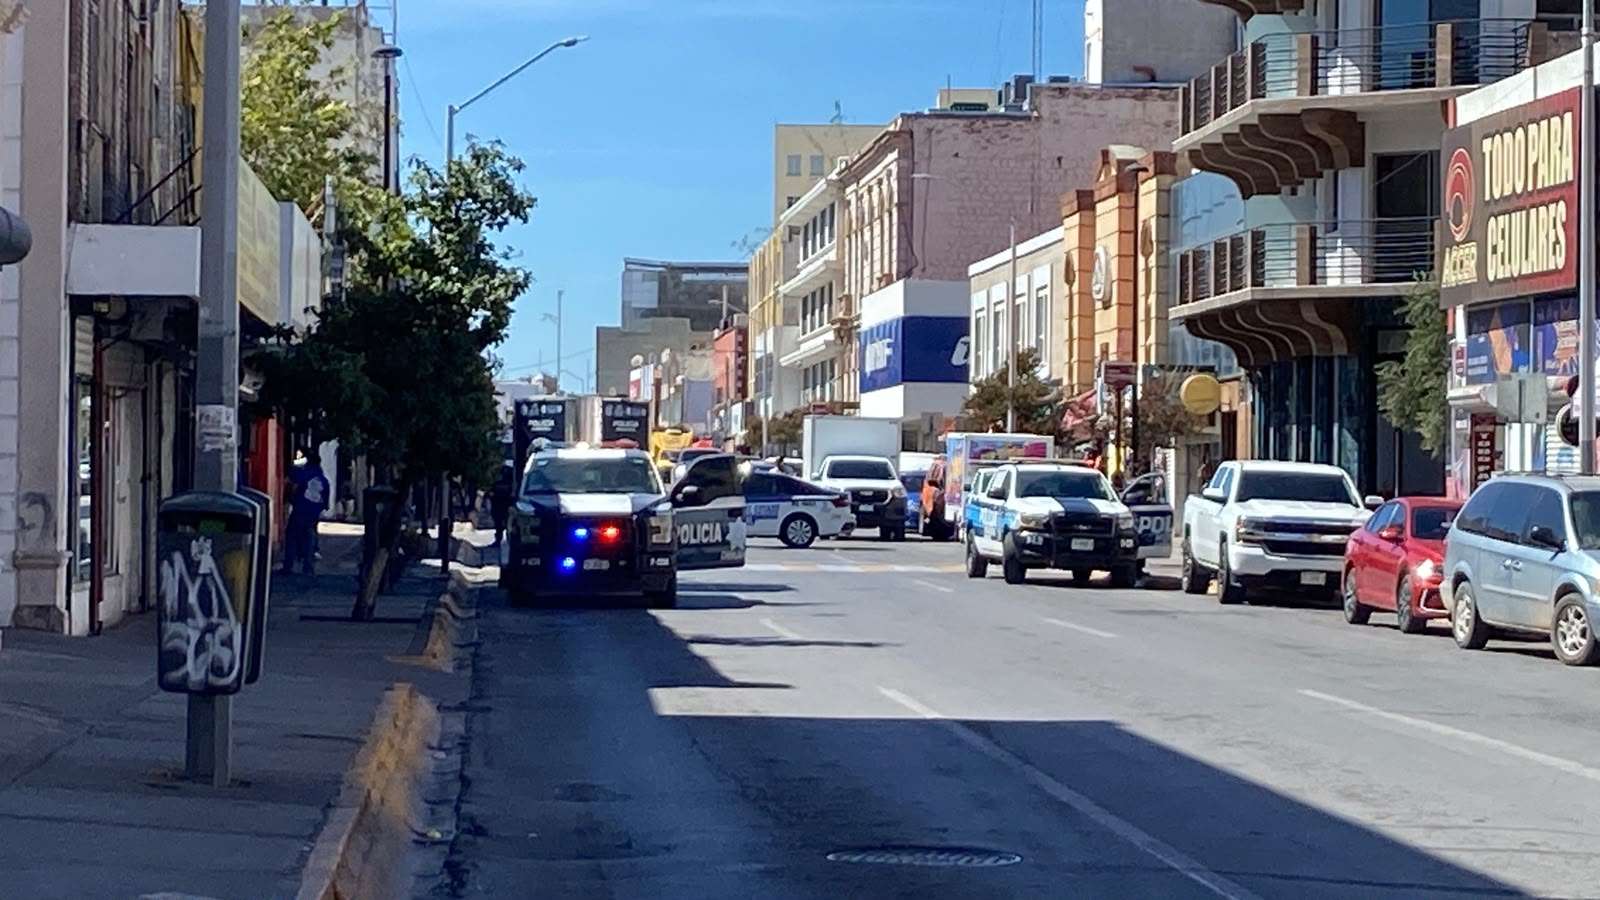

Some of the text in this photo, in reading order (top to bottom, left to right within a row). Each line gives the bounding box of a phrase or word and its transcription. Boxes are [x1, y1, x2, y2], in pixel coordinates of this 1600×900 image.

[1482, 111, 1574, 201] TODO PARA
[1487, 200, 1567, 282] CELULARES
